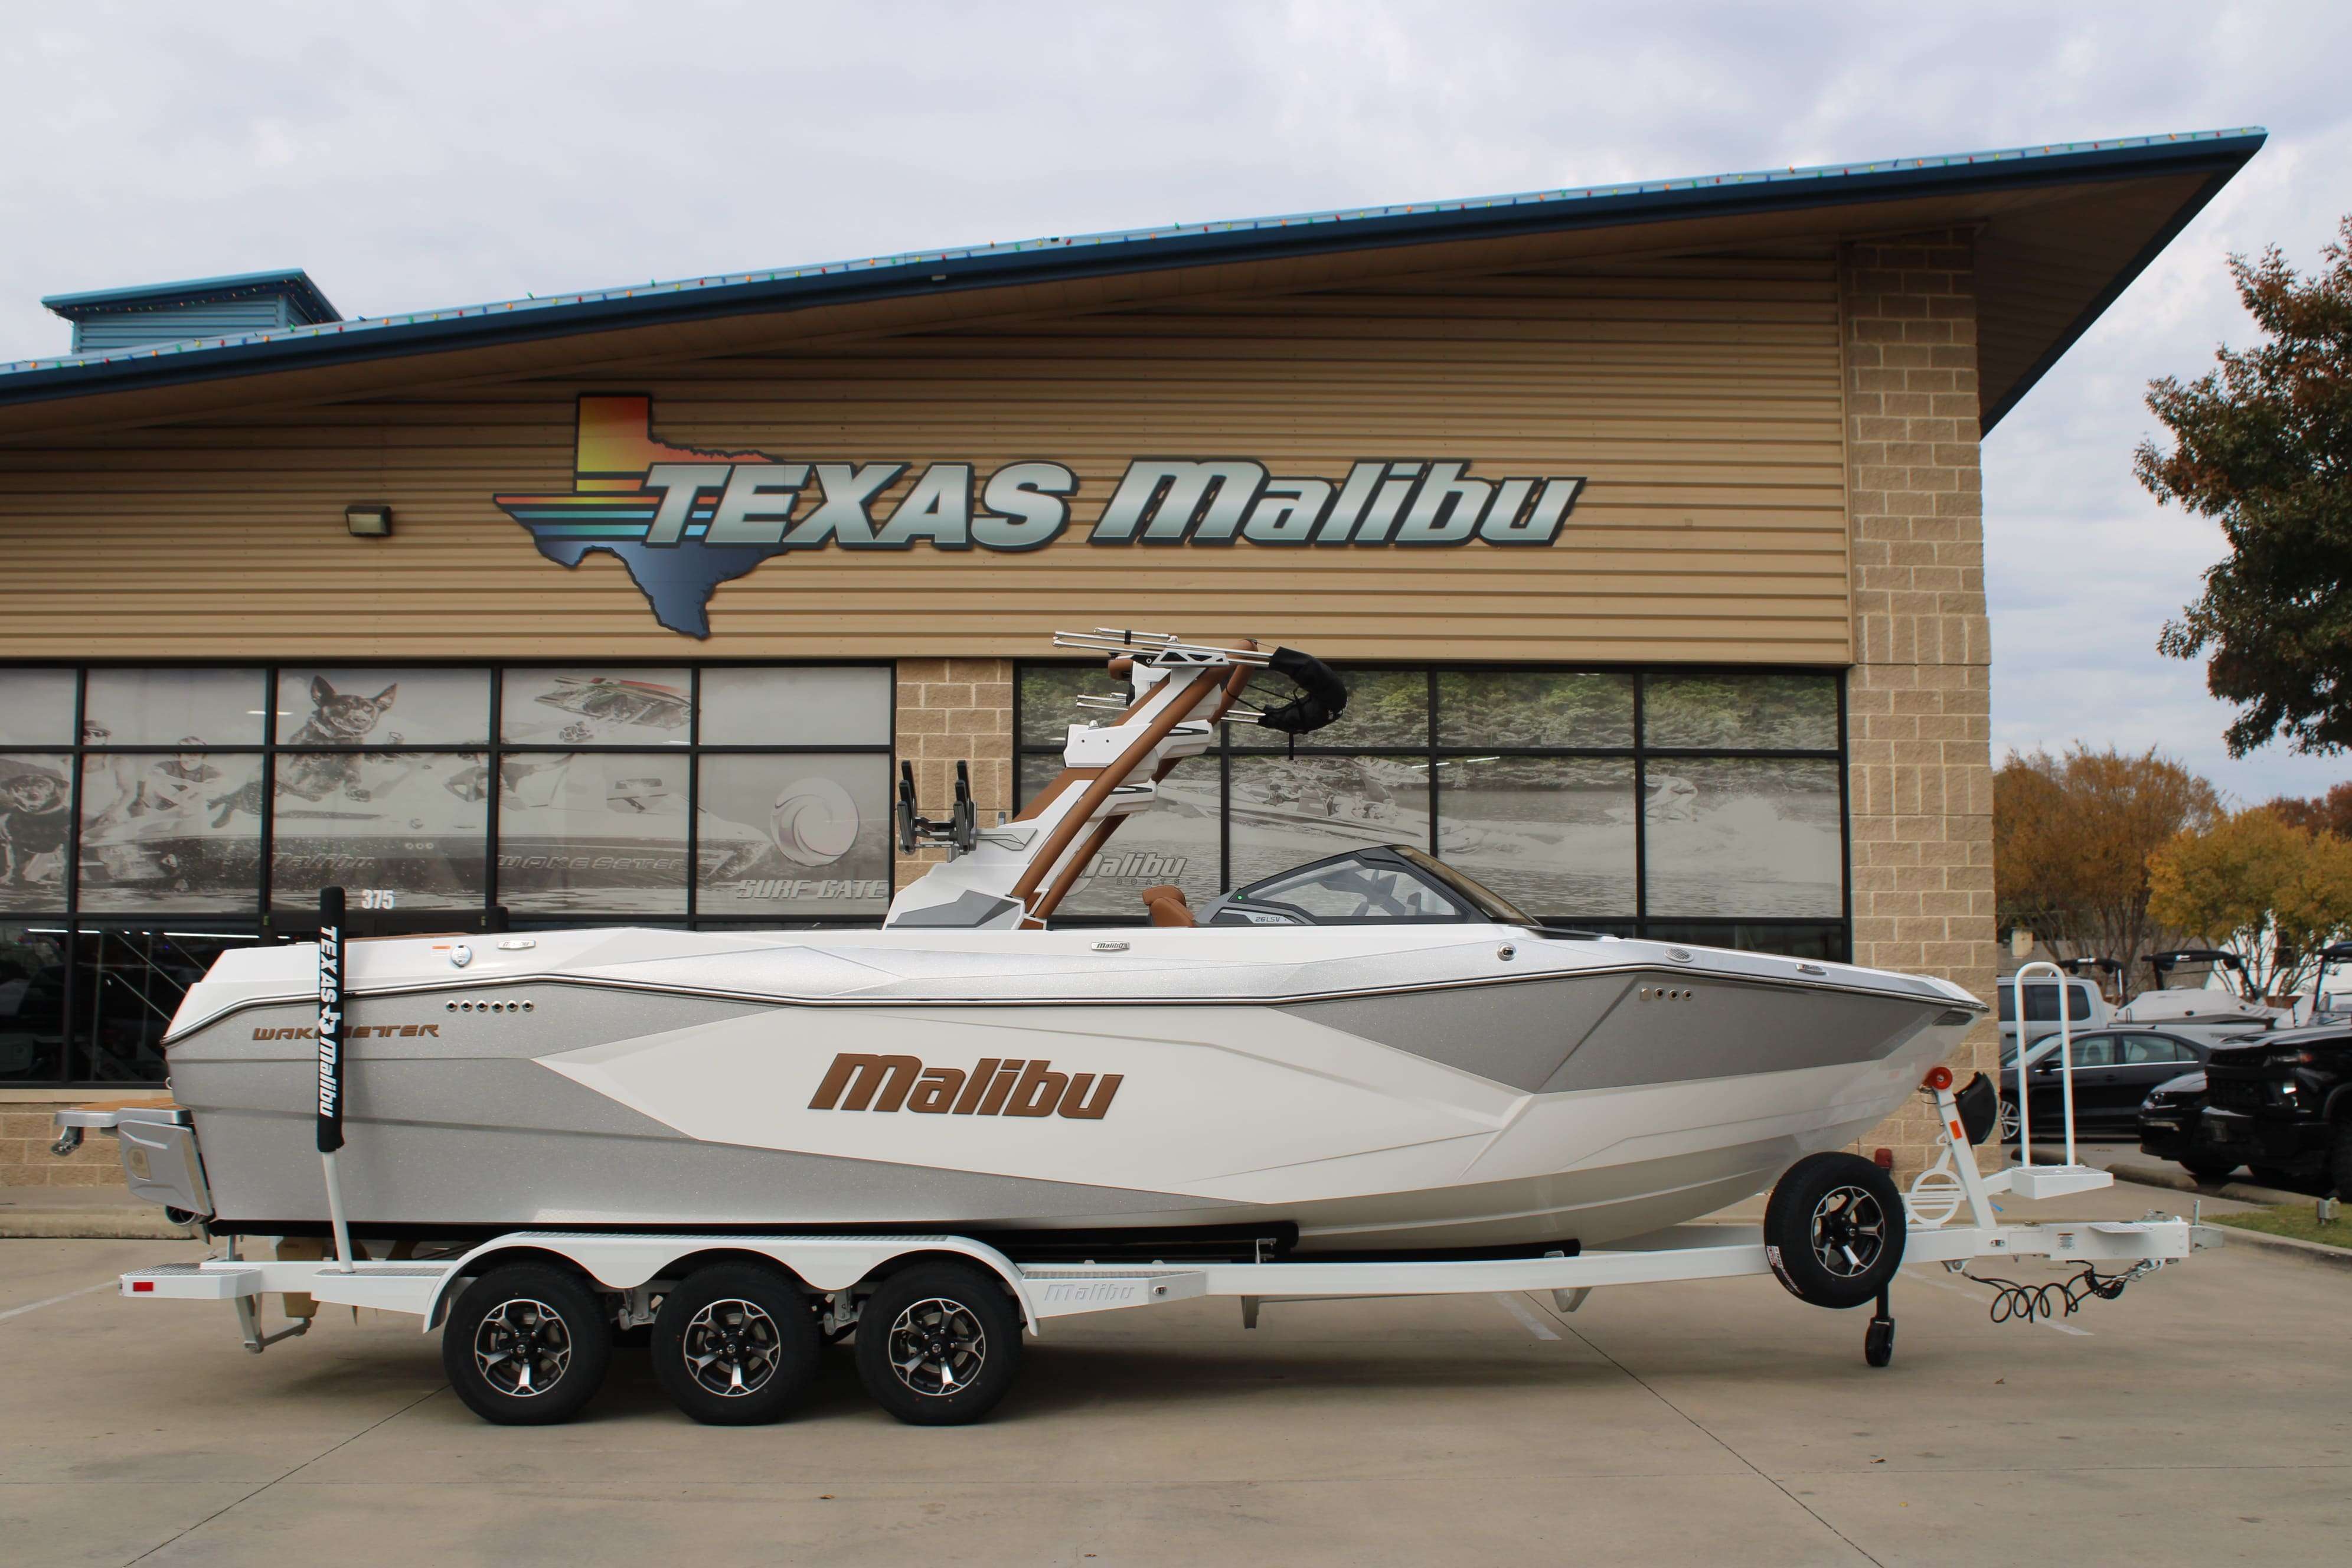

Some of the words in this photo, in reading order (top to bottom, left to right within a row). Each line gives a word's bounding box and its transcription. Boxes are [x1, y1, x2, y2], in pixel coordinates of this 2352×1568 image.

[642, 461, 1078, 552] TEXAS
[1087, 456, 1587, 548] Malibu
[361, 889, 394, 909] 375
[737, 879, 812, 899] SURF
[816, 879, 889, 899] GATE
[321, 925, 338, 1003] TEXAS
[252, 1024, 440, 1040] WAKETTER
[319, 1035, 337, 1118] Malibu
[807, 1053, 1125, 1120] Malibu
[1044, 1283, 1135, 1301] Malibu
